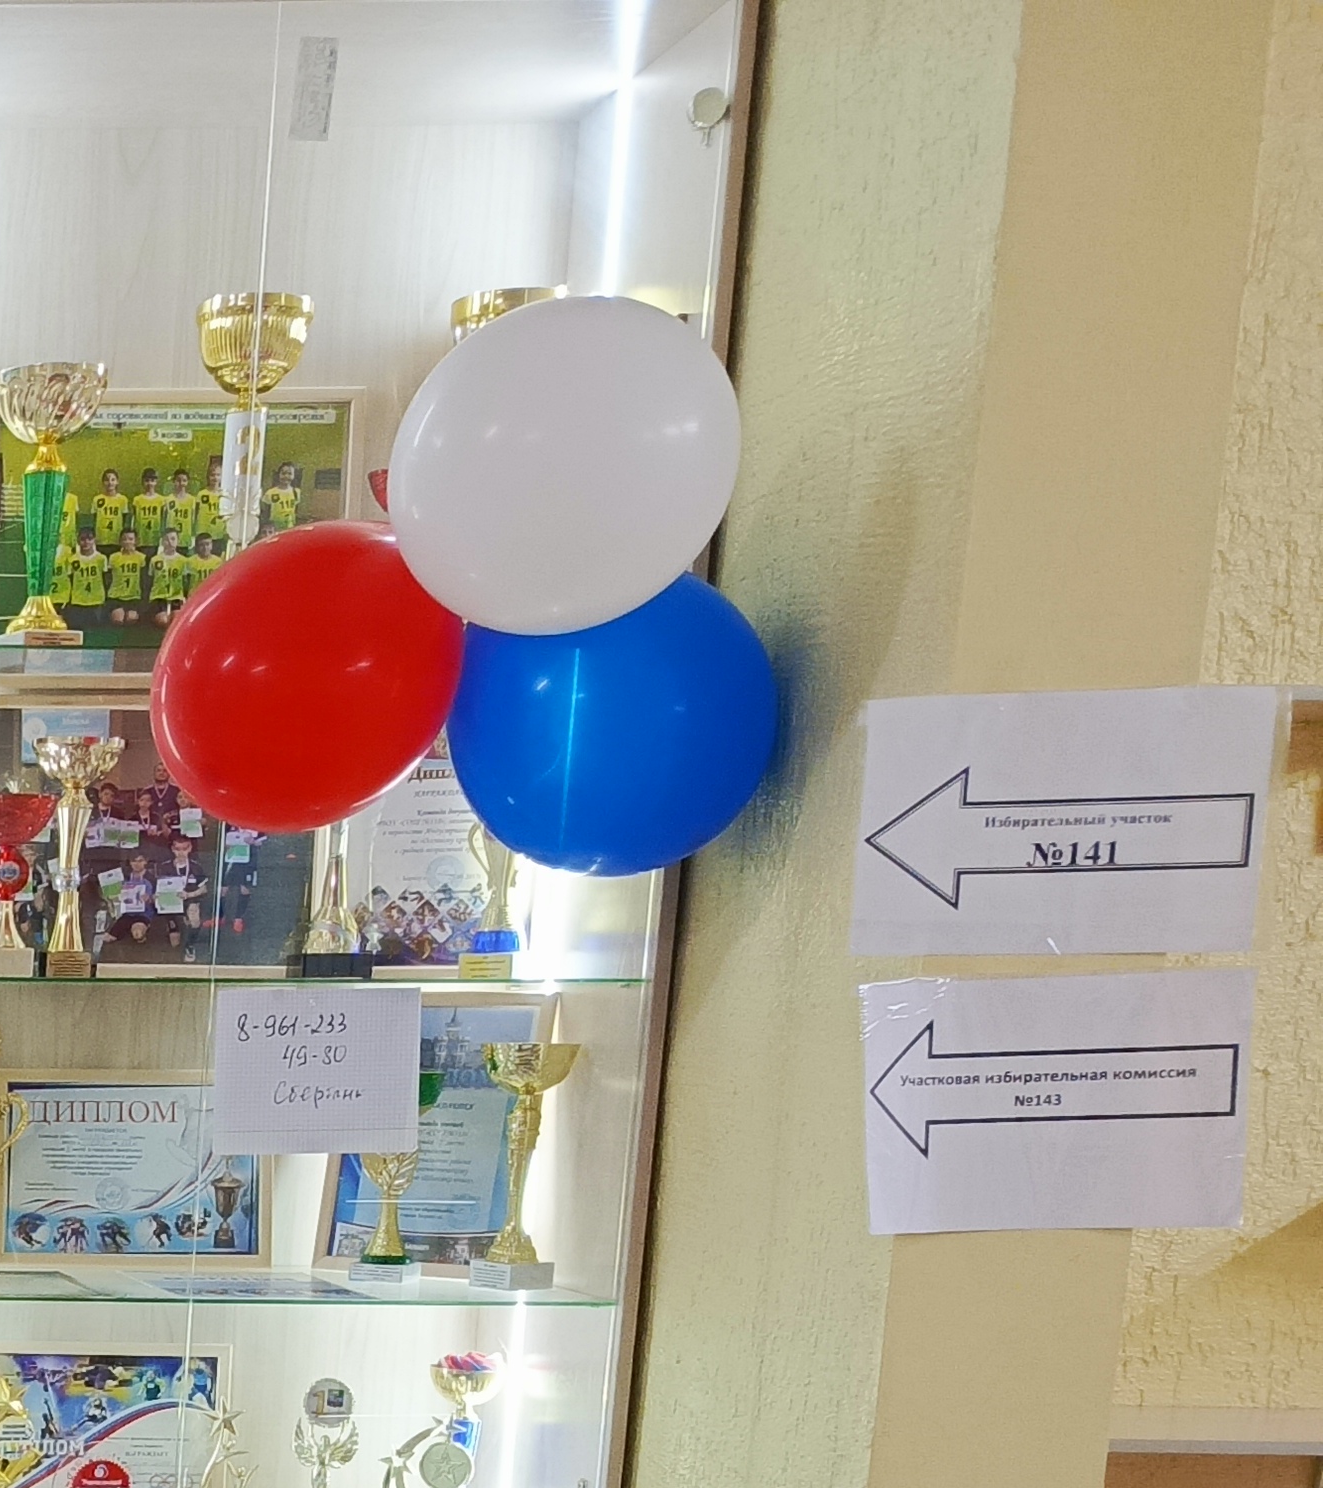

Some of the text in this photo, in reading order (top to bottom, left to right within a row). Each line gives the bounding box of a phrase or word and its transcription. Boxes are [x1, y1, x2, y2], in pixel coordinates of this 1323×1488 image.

[984, 810, 1173, 830] Избирательный участок
[1025, 840, 1118, 868] №141
[236, 1012, 348, 1042] 8-961-233
[899, 1065, 1197, 1088] Участковая избирательная комиссия
[1013, 1092, 1063, 1108] №143
[29, 1099, 178, 1127] ДИПЛОМ
